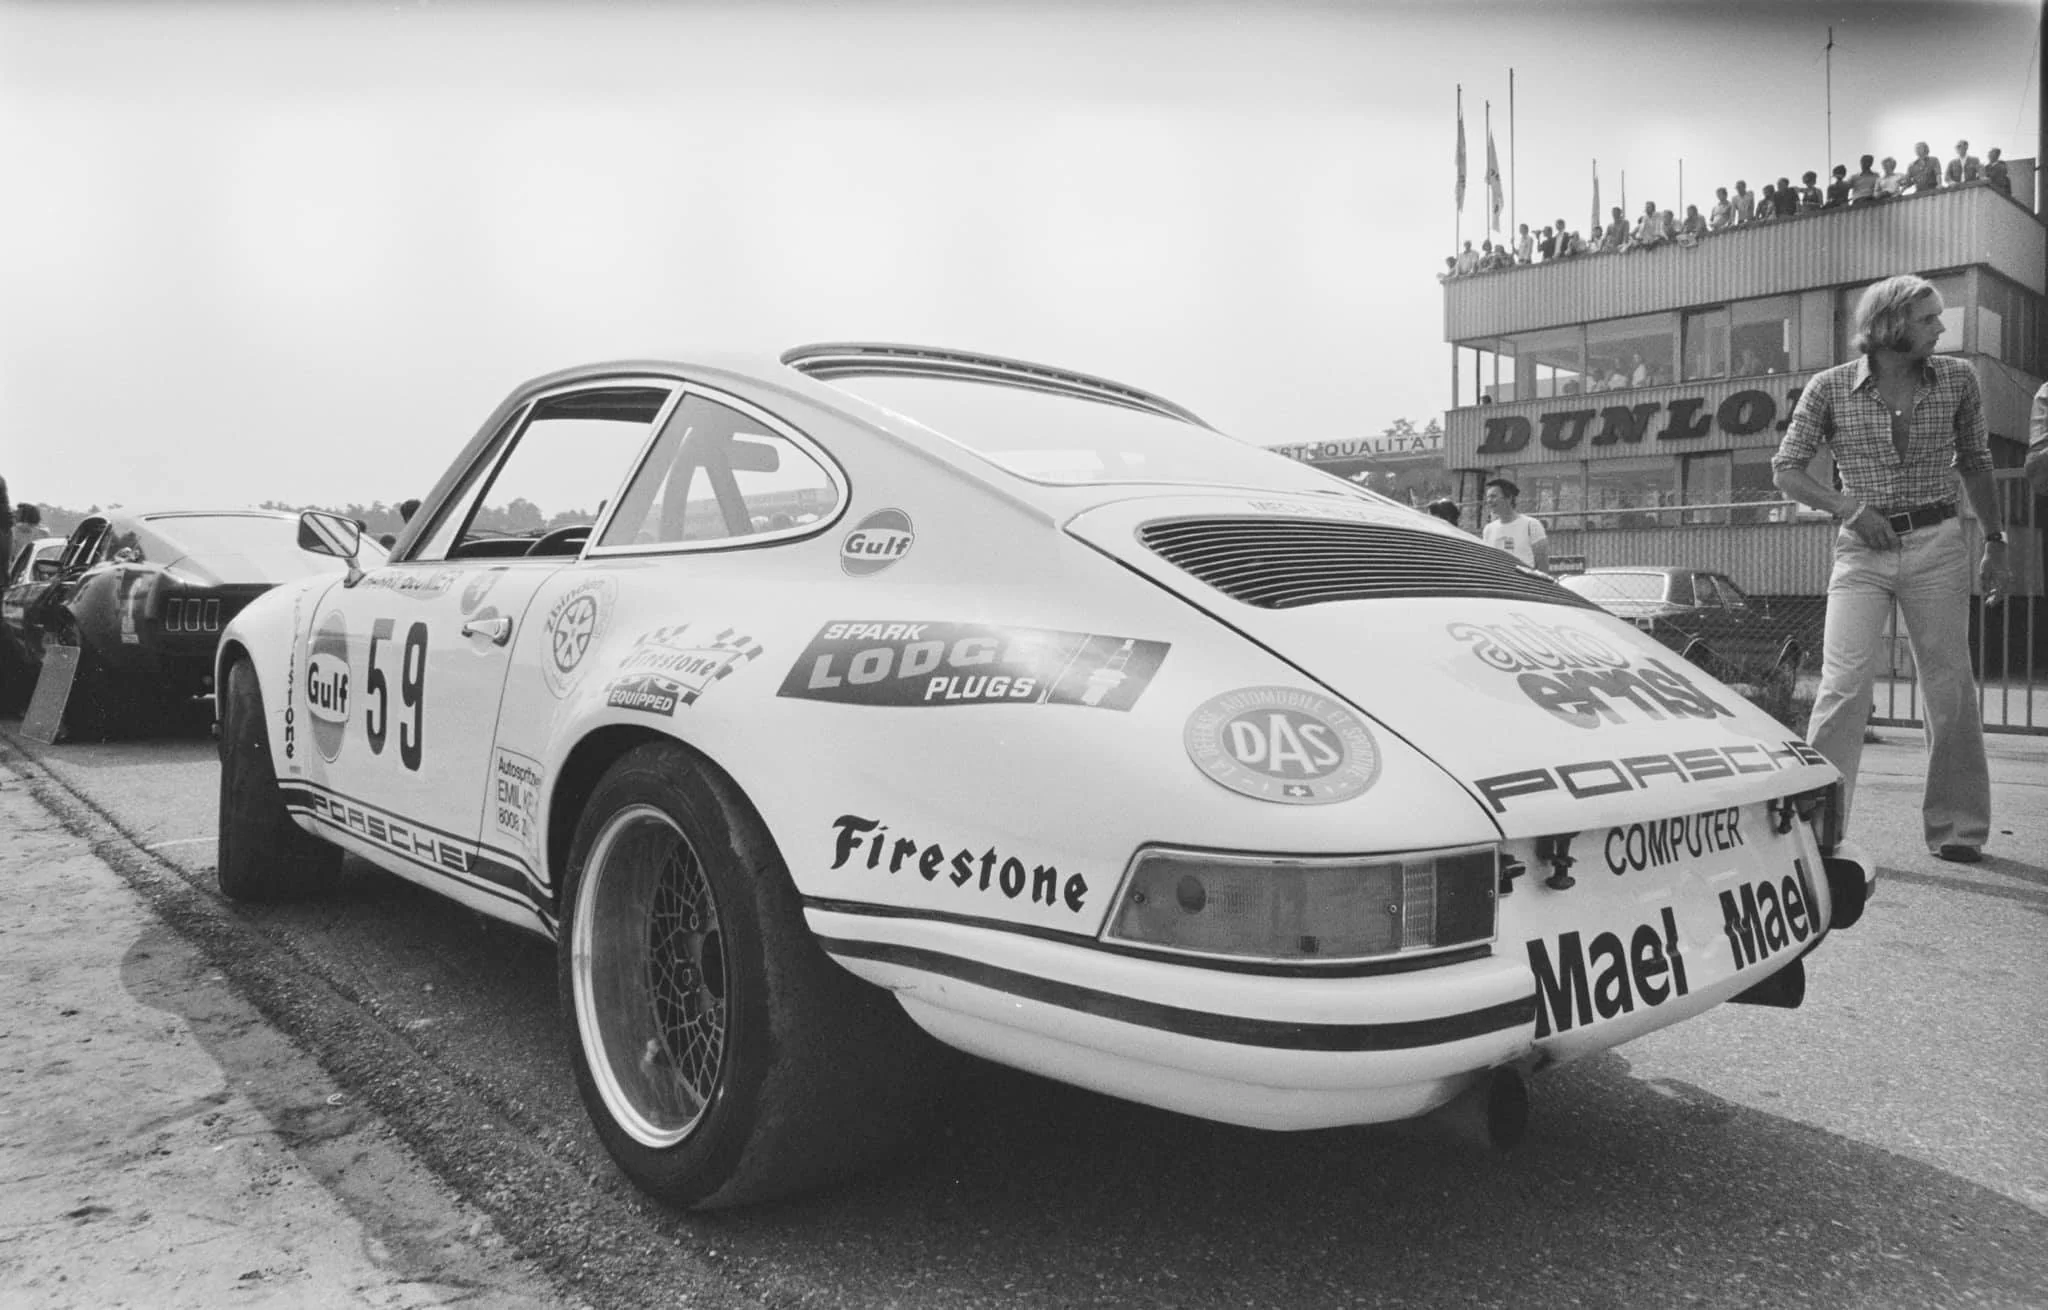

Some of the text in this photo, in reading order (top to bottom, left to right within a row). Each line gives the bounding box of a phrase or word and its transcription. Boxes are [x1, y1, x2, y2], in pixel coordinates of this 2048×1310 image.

[1477, 389, 1803, 455] DUNLO
[845, 533, 911, 555] Gulf
[824, 624, 930, 641] SPARK
[308, 662, 349, 714] Gulf
[367, 618, 428, 772] 59
[610, 690, 674, 712] EQUIPPED
[924, 677, 1036, 700] PLUGS
[1517, 657, 1736, 730] ernst
[1231, 714, 1340, 774] DAS
[1474, 741, 1828, 813] PORSCHE
[312, 793, 469, 873] PORSCHE
[830, 815, 1089, 913] Firestone
[1604, 806, 1745, 876] COMPUTER
[1719, 858, 1821, 971] Mael
[1526, 906, 1689, 1040] Mael
